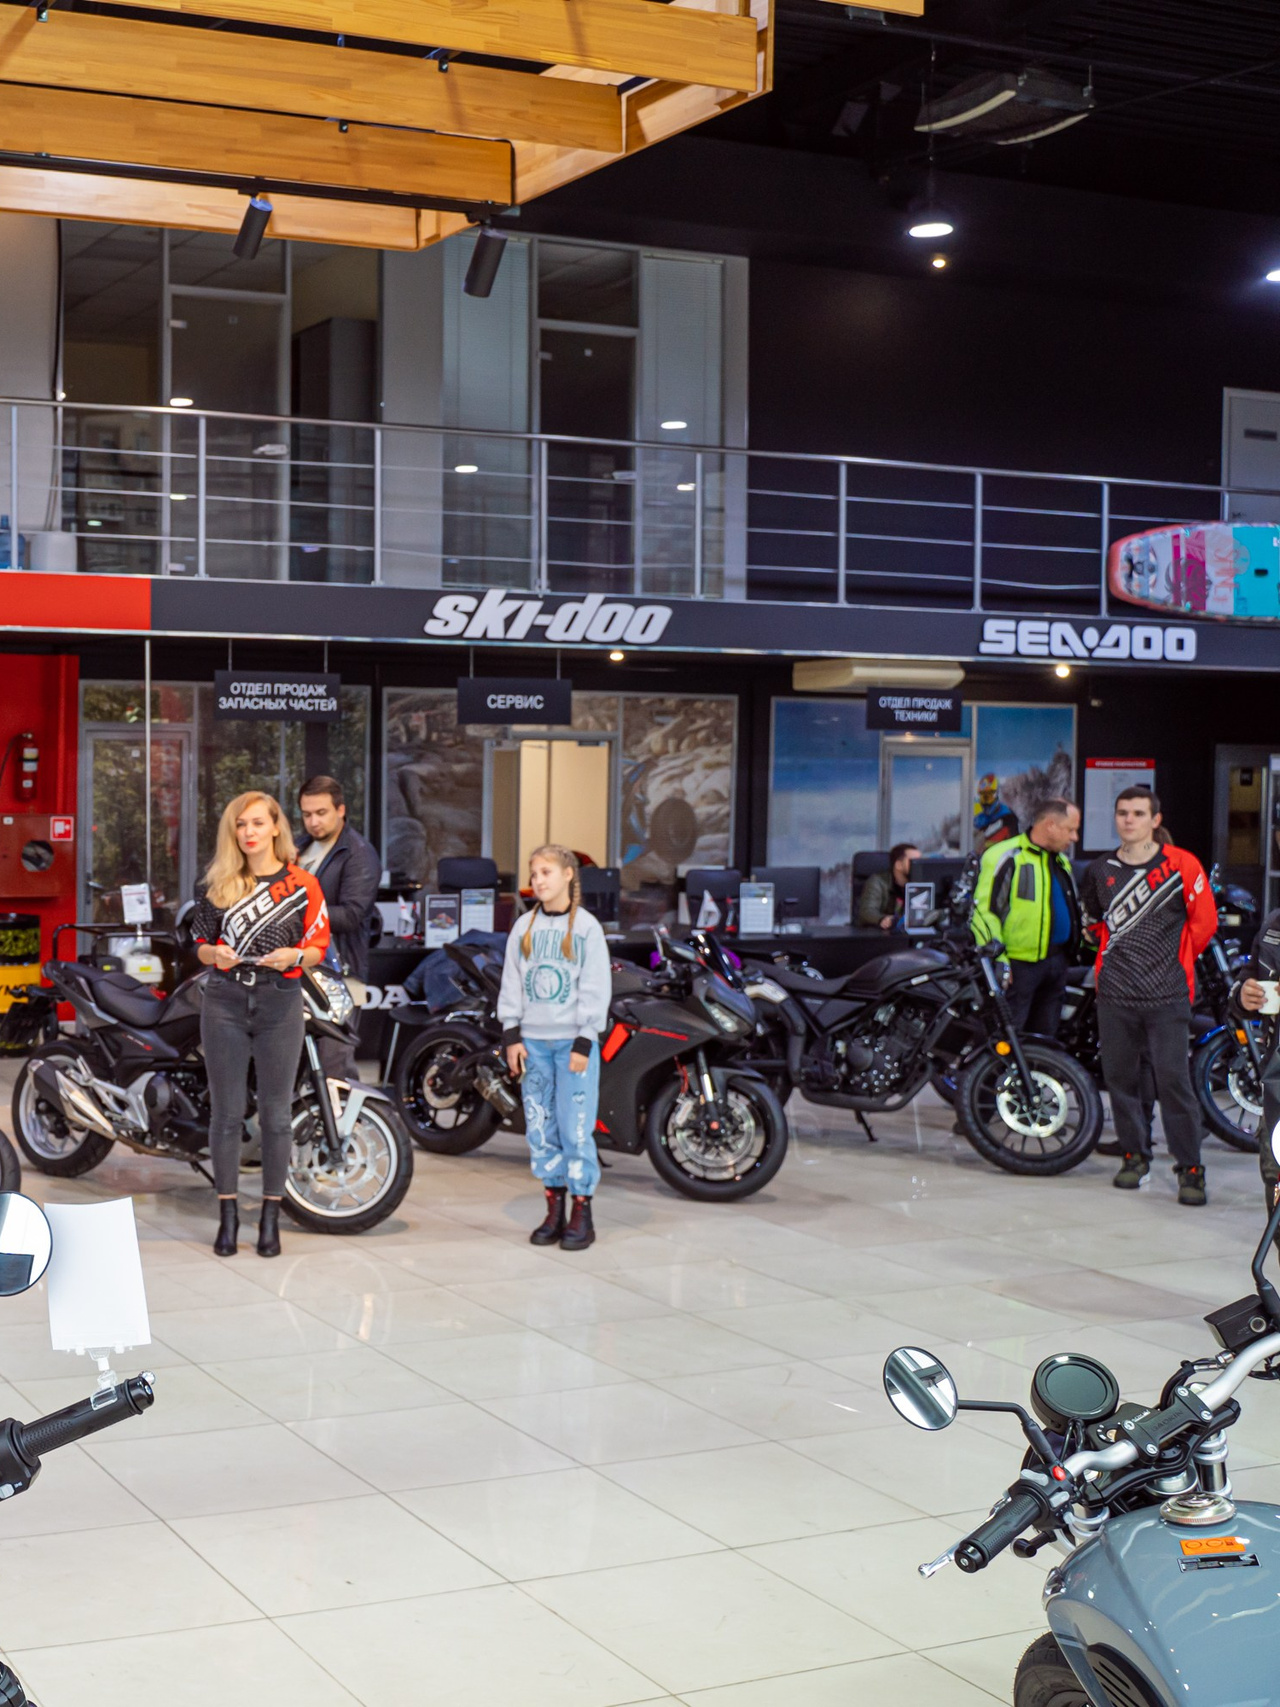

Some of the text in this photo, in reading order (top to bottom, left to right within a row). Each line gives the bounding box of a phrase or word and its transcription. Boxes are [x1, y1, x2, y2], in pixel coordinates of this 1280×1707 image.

[423, 588, 674, 645] ski-doo
[230, 681, 327, 698] ОТДЕЛ ПРОДАЖ
[218, 696, 338, 711] ЗАПАСНЫХ ЧАСТЕЙ
[486, 693, 545, 710] СЕРВИС
[878, 696, 953, 710] ОТДЕЛ ПРОДАЖ
[894, 709, 938, 722] ТЕХНИКИ
